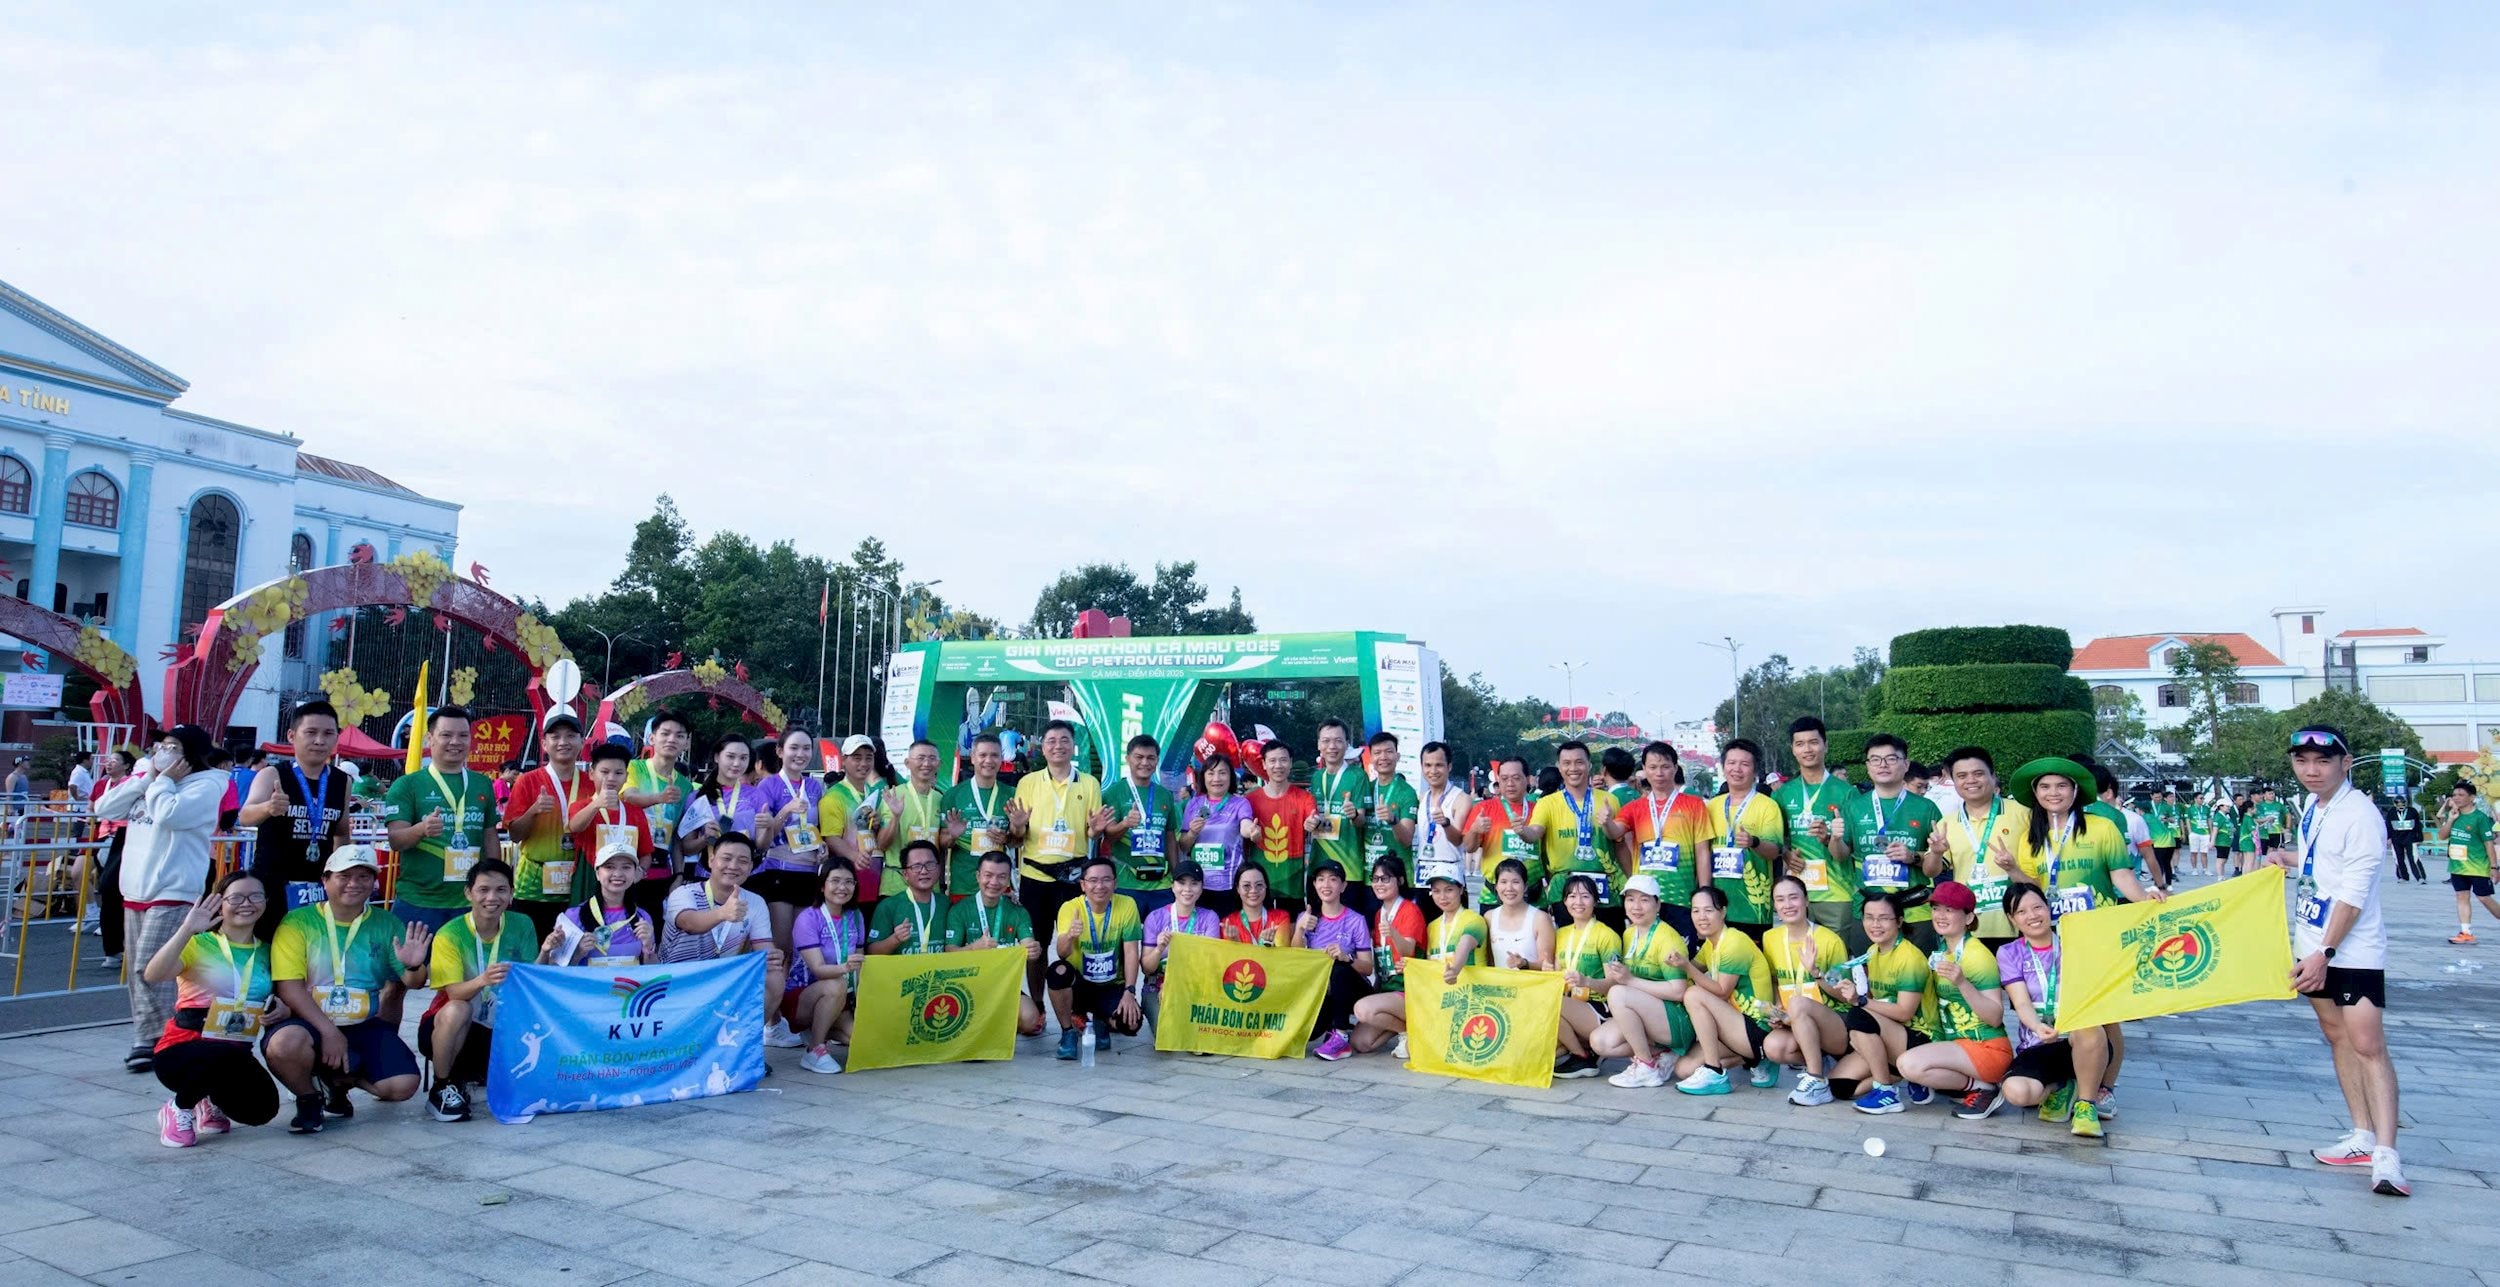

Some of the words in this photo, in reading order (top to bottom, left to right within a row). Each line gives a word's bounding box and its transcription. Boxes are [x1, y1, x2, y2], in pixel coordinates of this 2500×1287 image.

[19, 384, 70, 415] TỈNH
[1005, 642, 1040, 656] GIẢI
[1045, 642, 1151, 656] MARATHON
[1186, 641, 1231, 653] MAU
[1235, 640, 1280, 652] 2025
[1055, 656, 1089, 667] CUP
[1092, 654, 1224, 666] PETROVIETNAM
[1104, 670, 1123, 678] MAU
[1166, 669, 1184, 677] 2025
[1195, 851, 1220, 863] 53319
[1868, 864, 1901, 877] 21487
[2051, 897, 2087, 915] 21478
[1190, 1003, 1220, 1026] PHÂN
[1221, 1008, 1244, 1029] BÓN
[1262, 1013, 1287, 1032] MAU
